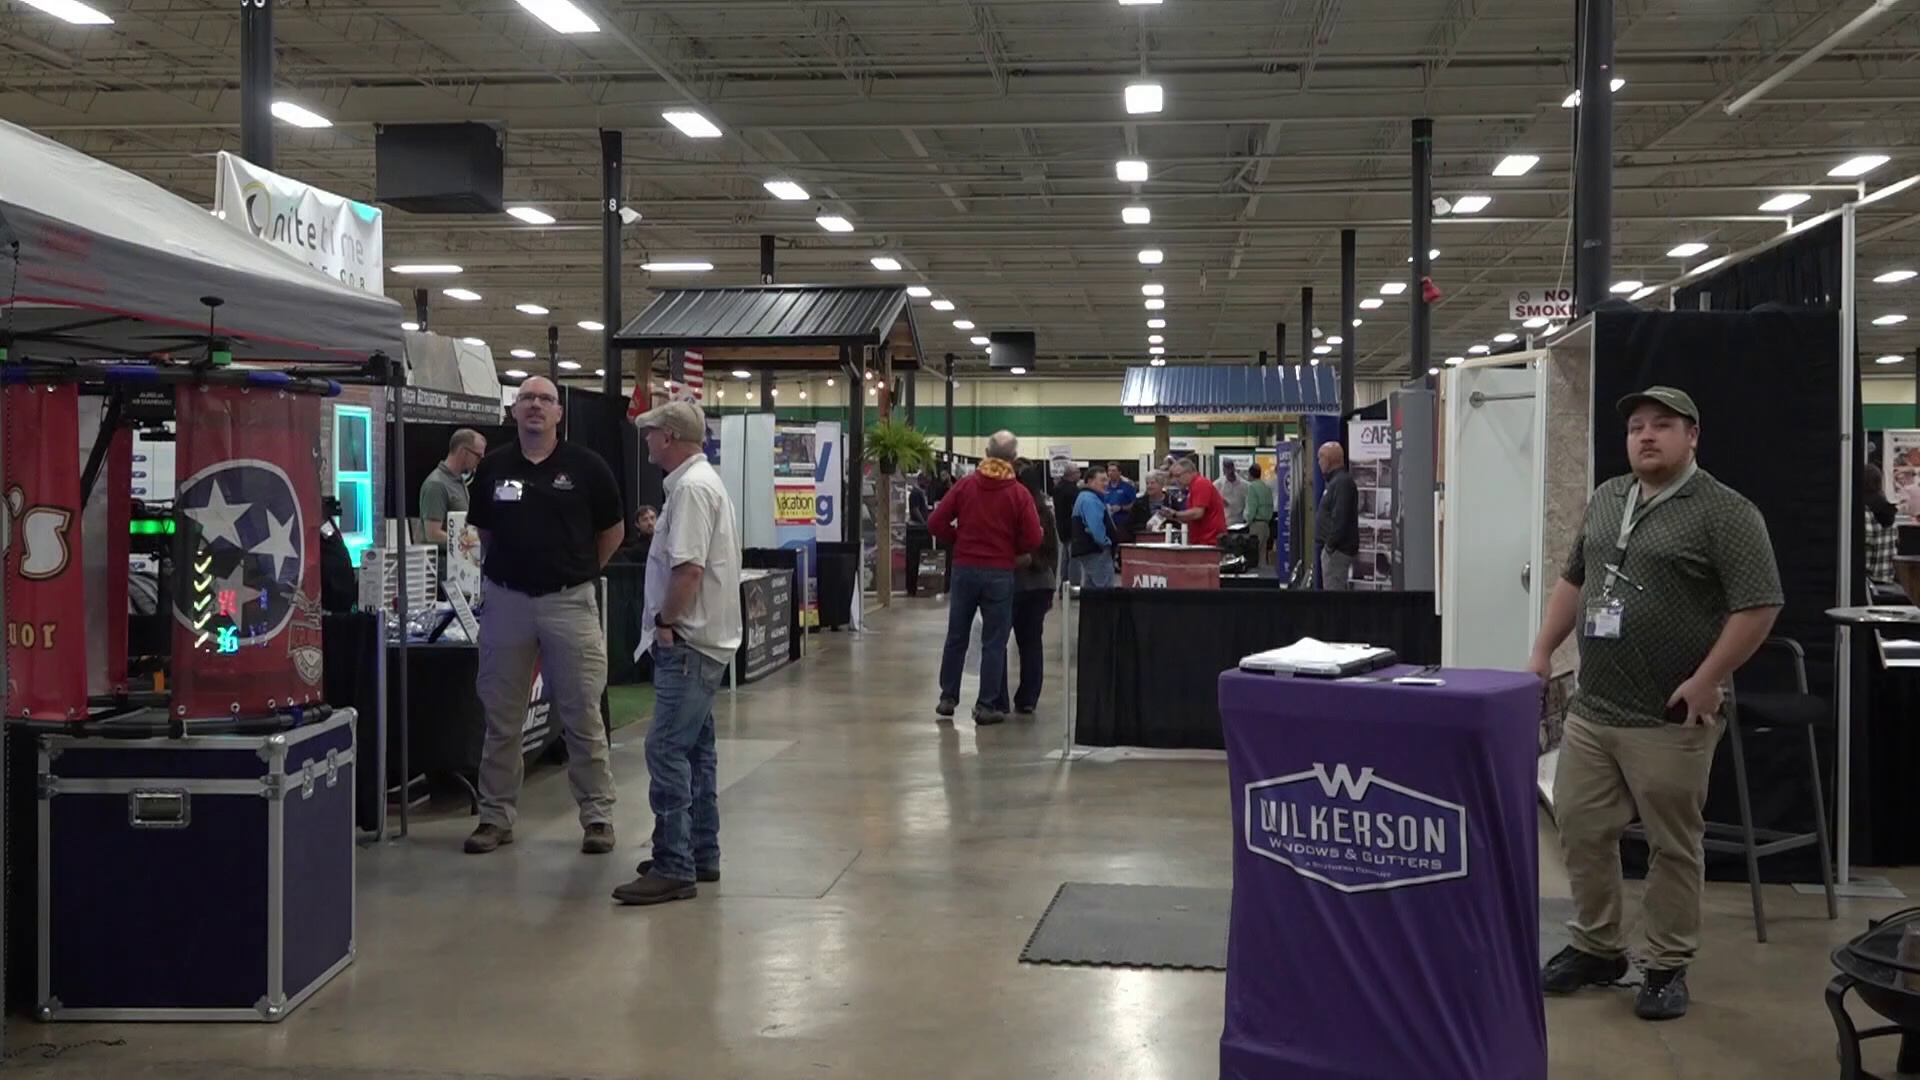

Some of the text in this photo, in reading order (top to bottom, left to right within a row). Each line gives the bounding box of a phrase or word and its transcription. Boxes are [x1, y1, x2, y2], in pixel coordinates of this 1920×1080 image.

[1544, 289, 1570, 302] NO
[1127, 404, 1160, 414] METAL
[1163, 404, 1208, 414] ROOFING
[1219, 404, 1247, 414] POST
[1248, 404, 1283, 413] FRAME
[1286, 403, 1341, 413] BUILDINGS
[1259, 797, 1446, 854] WILKERSON
[1344, 848, 1358, 861] &
[1362, 852, 1443, 871] GUTTERS
